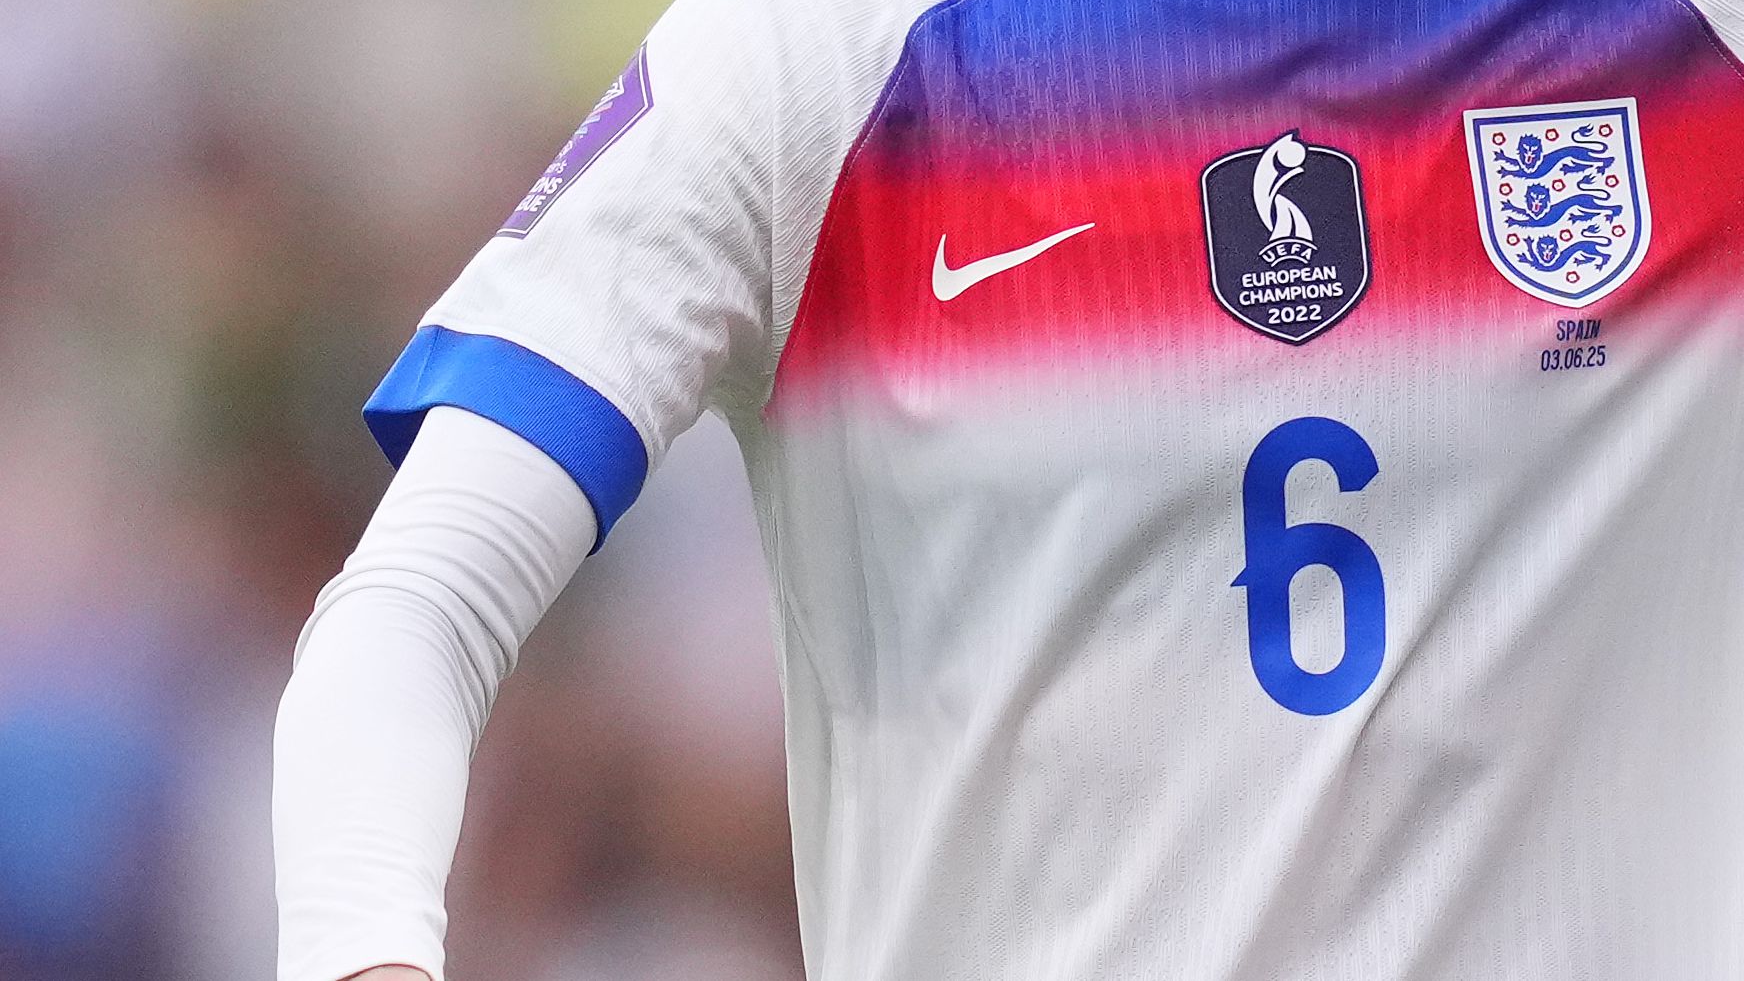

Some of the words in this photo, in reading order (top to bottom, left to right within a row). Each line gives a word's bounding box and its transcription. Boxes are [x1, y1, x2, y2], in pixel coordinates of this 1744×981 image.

[1261, 243, 1312, 263] UEFA
[1241, 265, 1337, 288] EUROPEAN
[1239, 282, 1344, 306] CHAMPIONS
[1268, 304, 1322, 324] 2022
[1556, 319, 1602, 341] SPAIN
[1541, 345, 1606, 372] 03.06.25
[1230, 416, 1386, 716] 6
